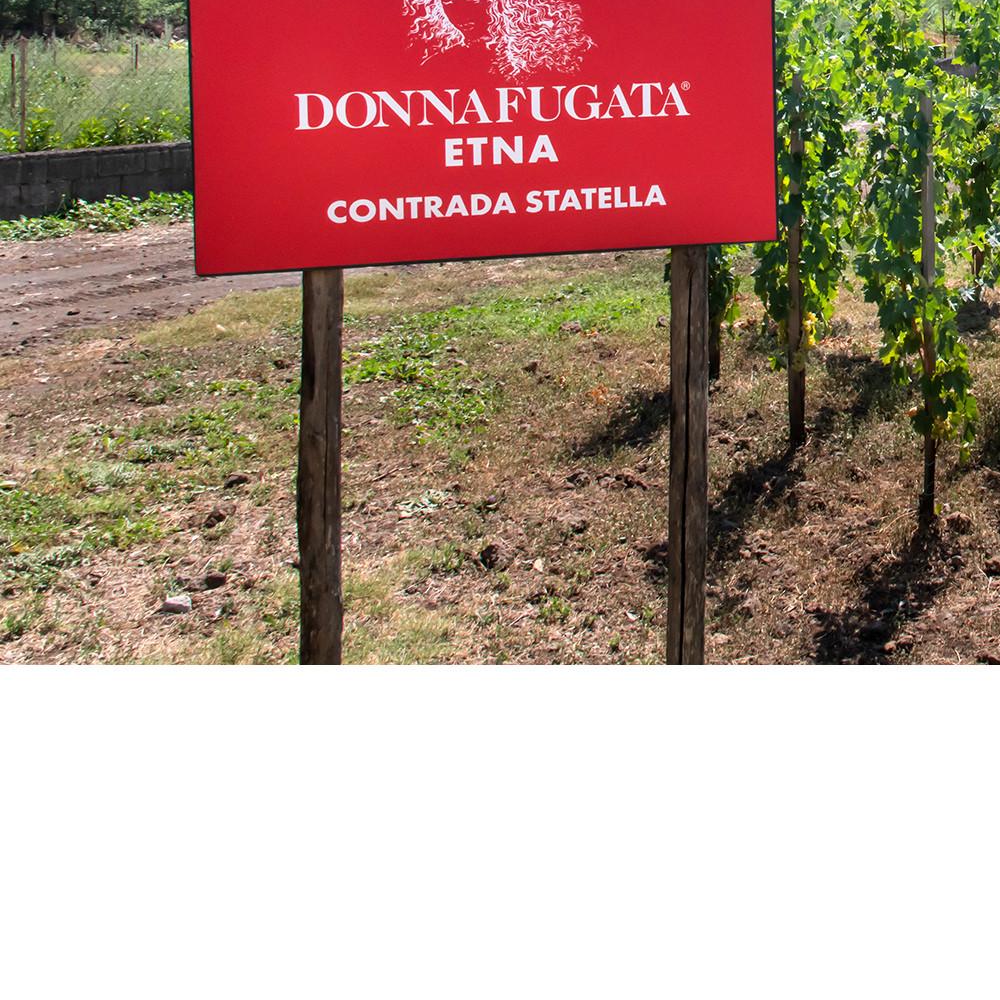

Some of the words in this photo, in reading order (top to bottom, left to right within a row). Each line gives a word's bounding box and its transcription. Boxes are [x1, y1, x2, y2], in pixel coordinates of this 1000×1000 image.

[444, 134, 559, 168] ETNA
[326, 191, 516, 224] CONTRADA
[525, 184, 667, 214] STATELLA
